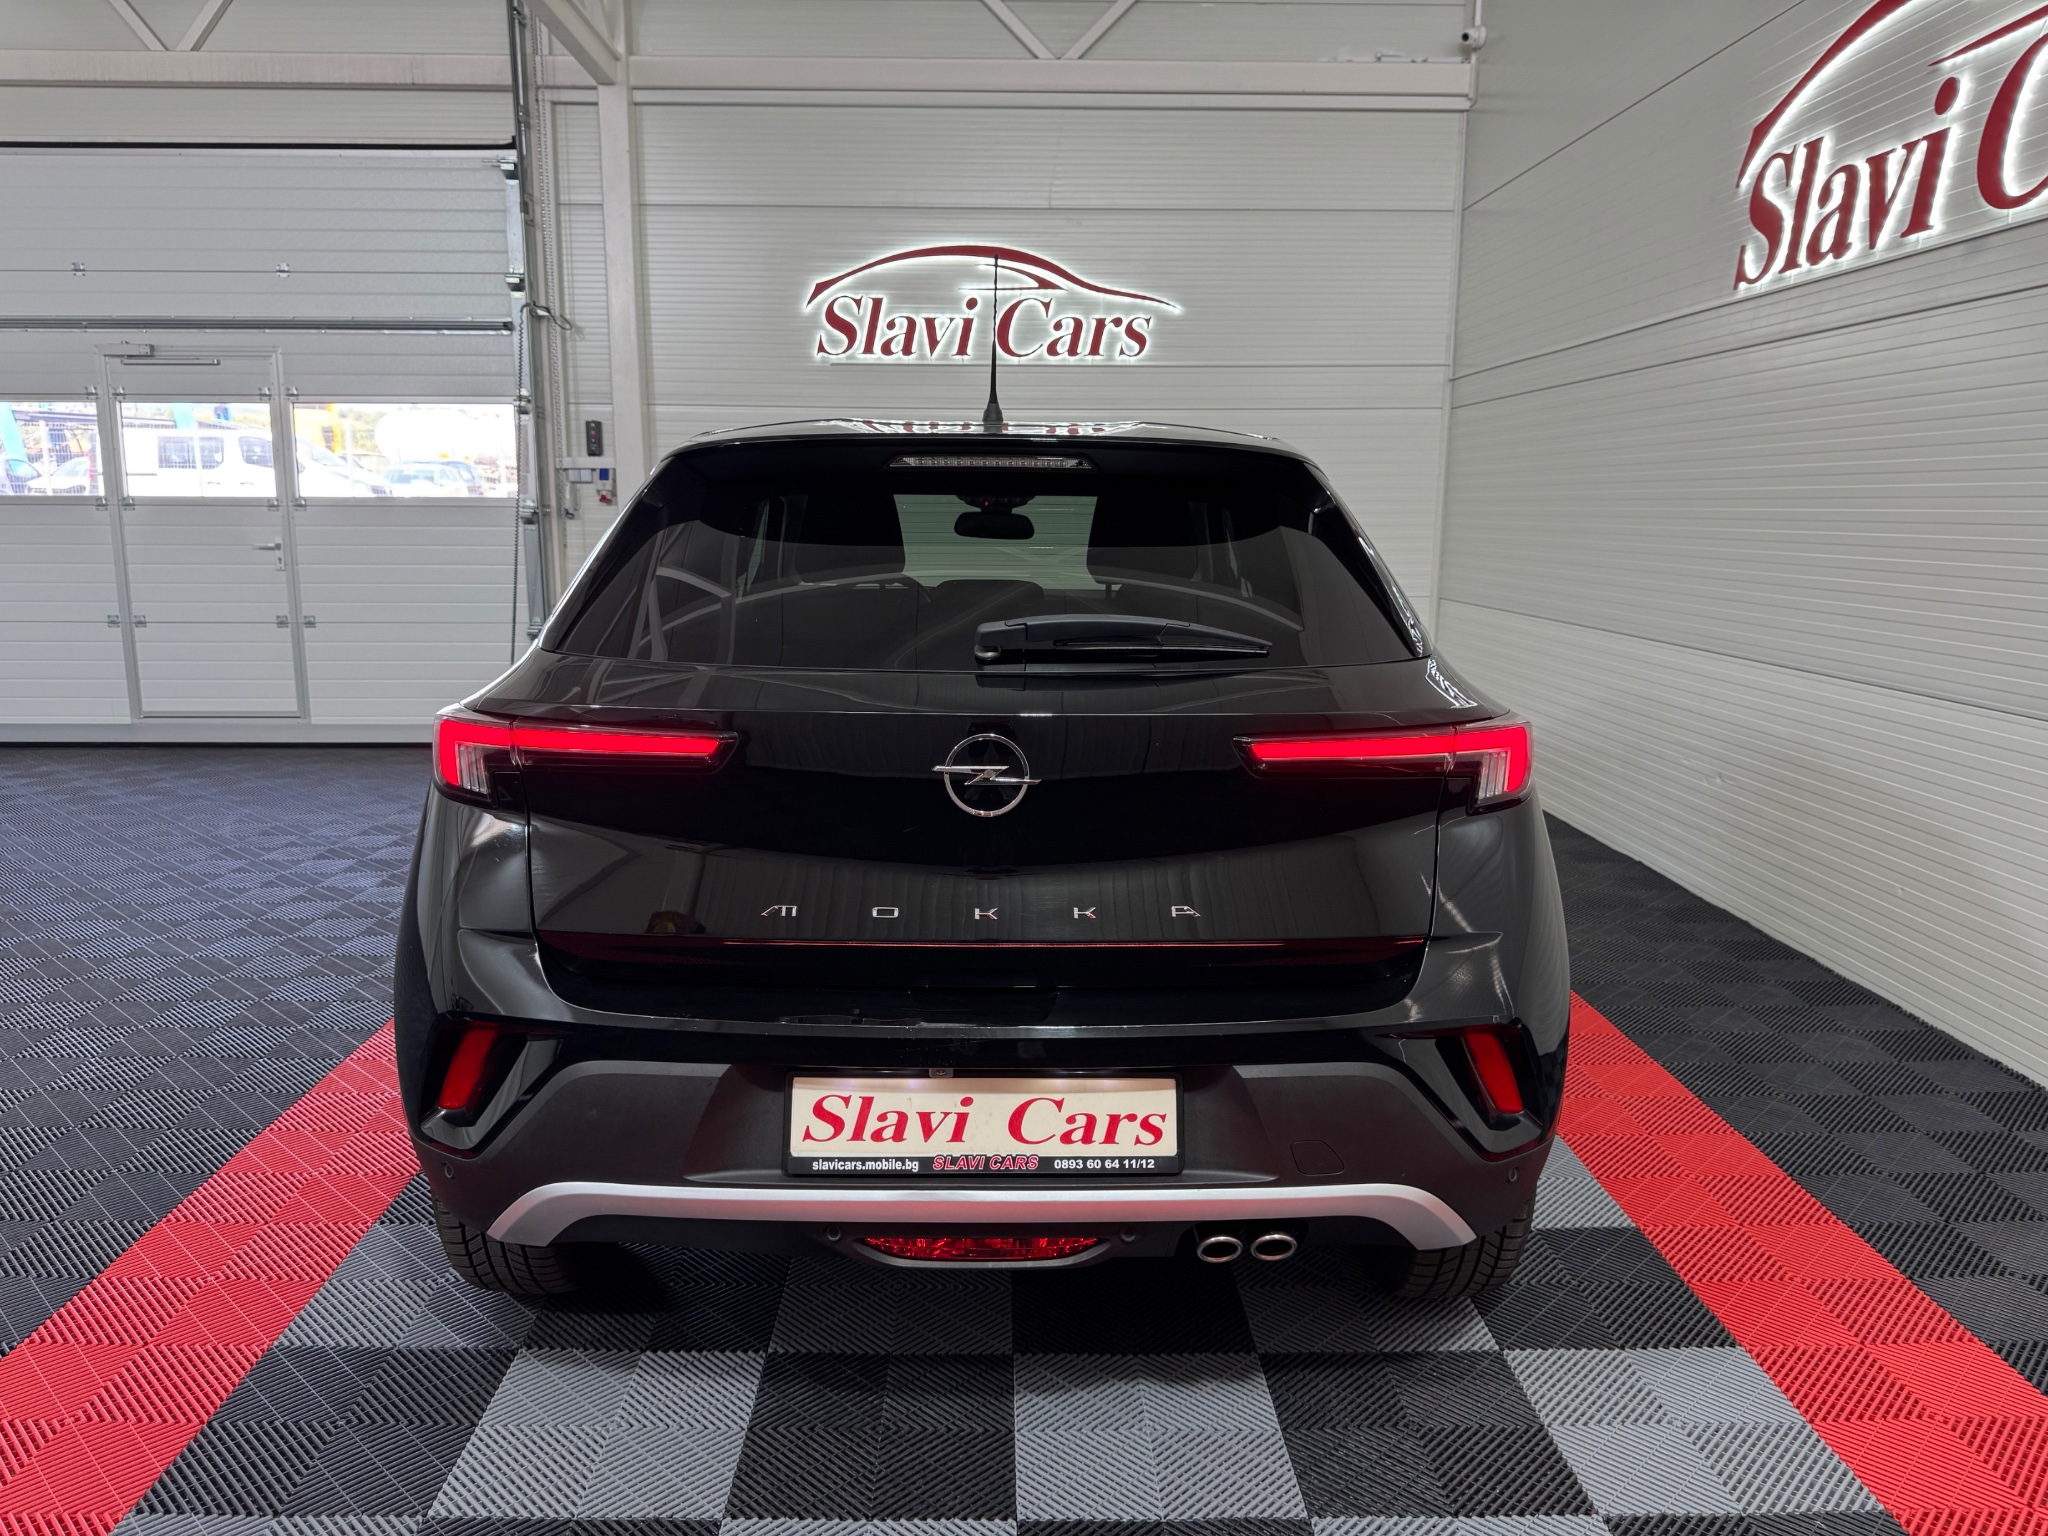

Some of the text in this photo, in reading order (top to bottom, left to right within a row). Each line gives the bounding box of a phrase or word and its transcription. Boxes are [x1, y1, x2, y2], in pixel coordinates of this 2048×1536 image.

[1733, 77, 1960, 290] Slavi
[817, 295, 1151, 358] Slavi Cars
[761, 904, 1201, 919] MOKKA
[802, 1094, 1167, 1146] Slavi Cars
[812, 1158, 919, 1172] slavicars.mobile.bg
[932, 1155, 1039, 1170] SLAVI CARS
[1054, 1158, 1155, 1169] 0893 60 64 11/12
